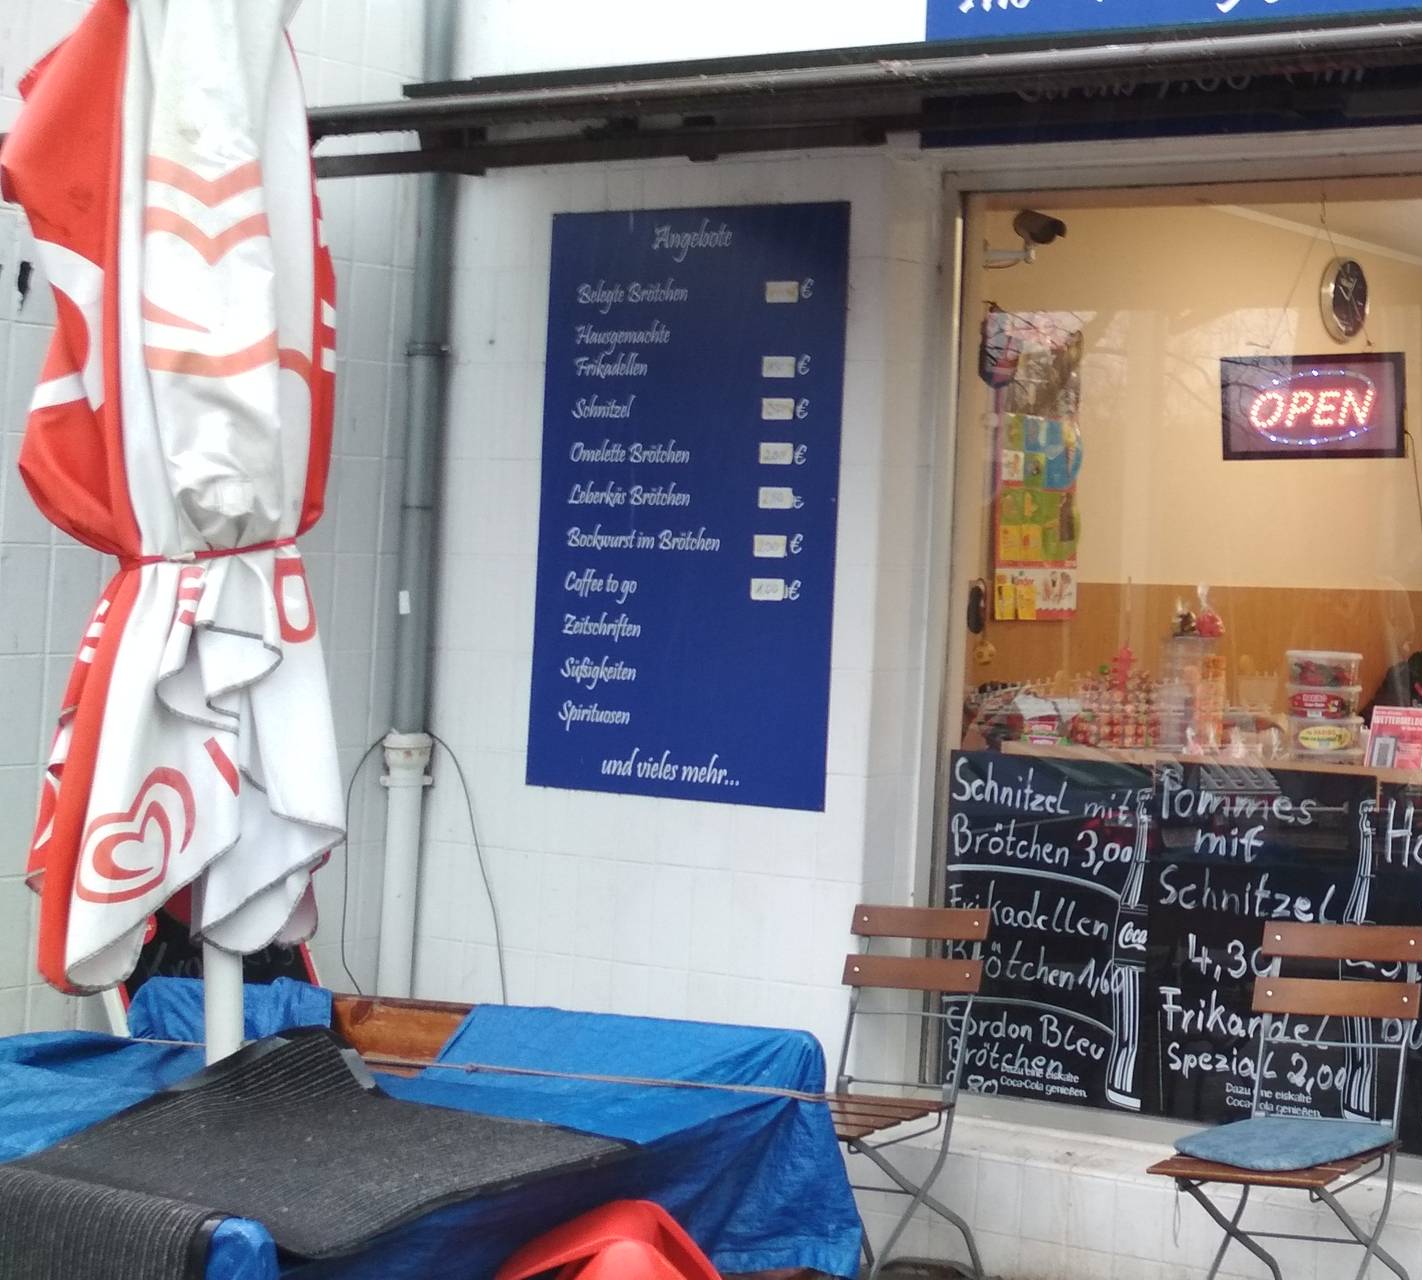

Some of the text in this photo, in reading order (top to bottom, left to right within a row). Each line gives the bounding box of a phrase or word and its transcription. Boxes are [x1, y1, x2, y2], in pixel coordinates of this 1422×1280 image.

[652, 218, 734, 262] Angebote
[577, 279, 626, 313] Belegte
[629, 278, 689, 303] Brötchen
[801, 277, 814, 299] €
[575, 321, 671, 354] Hausgemachte
[575, 353, 648, 378] Frikadellen
[797, 354, 810, 376] €
[571, 394, 634, 419] Schnitzel
[796, 398, 809, 419] €
[1250, 389, 1375, 428] OPEN
[569, 440, 626, 464] Omelette
[629, 439, 690, 464] Brötchen
[794, 444, 807, 465] €
[568, 481, 627, 506] Leberkäs
[630, 482, 691, 506] Brötchen
[567, 524, 636, 551] Bockwurst
[638, 530, 655, 549] im
[658, 527, 721, 552] Brötchen
[789, 533, 803, 554] €
[564, 569, 603, 598] Coffee
[606, 573, 618, 593] to
[616, 580, 638, 604] go
[788, 579, 801, 601] €
[563, 611, 641, 642] Zeitschriften
[560, 656, 637, 689] Süßigkeiten
[558, 700, 630, 731] Spirituosen
[601, 748, 740, 786] und vieles mehr...
[951, 757, 1134, 827] Schnitzel mit
[1160, 768, 1317, 825] Pommes
[951, 813, 1071, 866] Brötchen
[1194, 825, 1265, 863] mit
[1159, 864, 1337, 925] Schnitzel
[1119, 922, 1147, 950] Coca
[1039, 1014, 1105, 1060] Bleu
[1167, 1042, 1278, 1080] Spezial
[1000, 1075, 1044, 1092] Coca-Cola
[1225, 1082, 1251, 1096] Dazu
